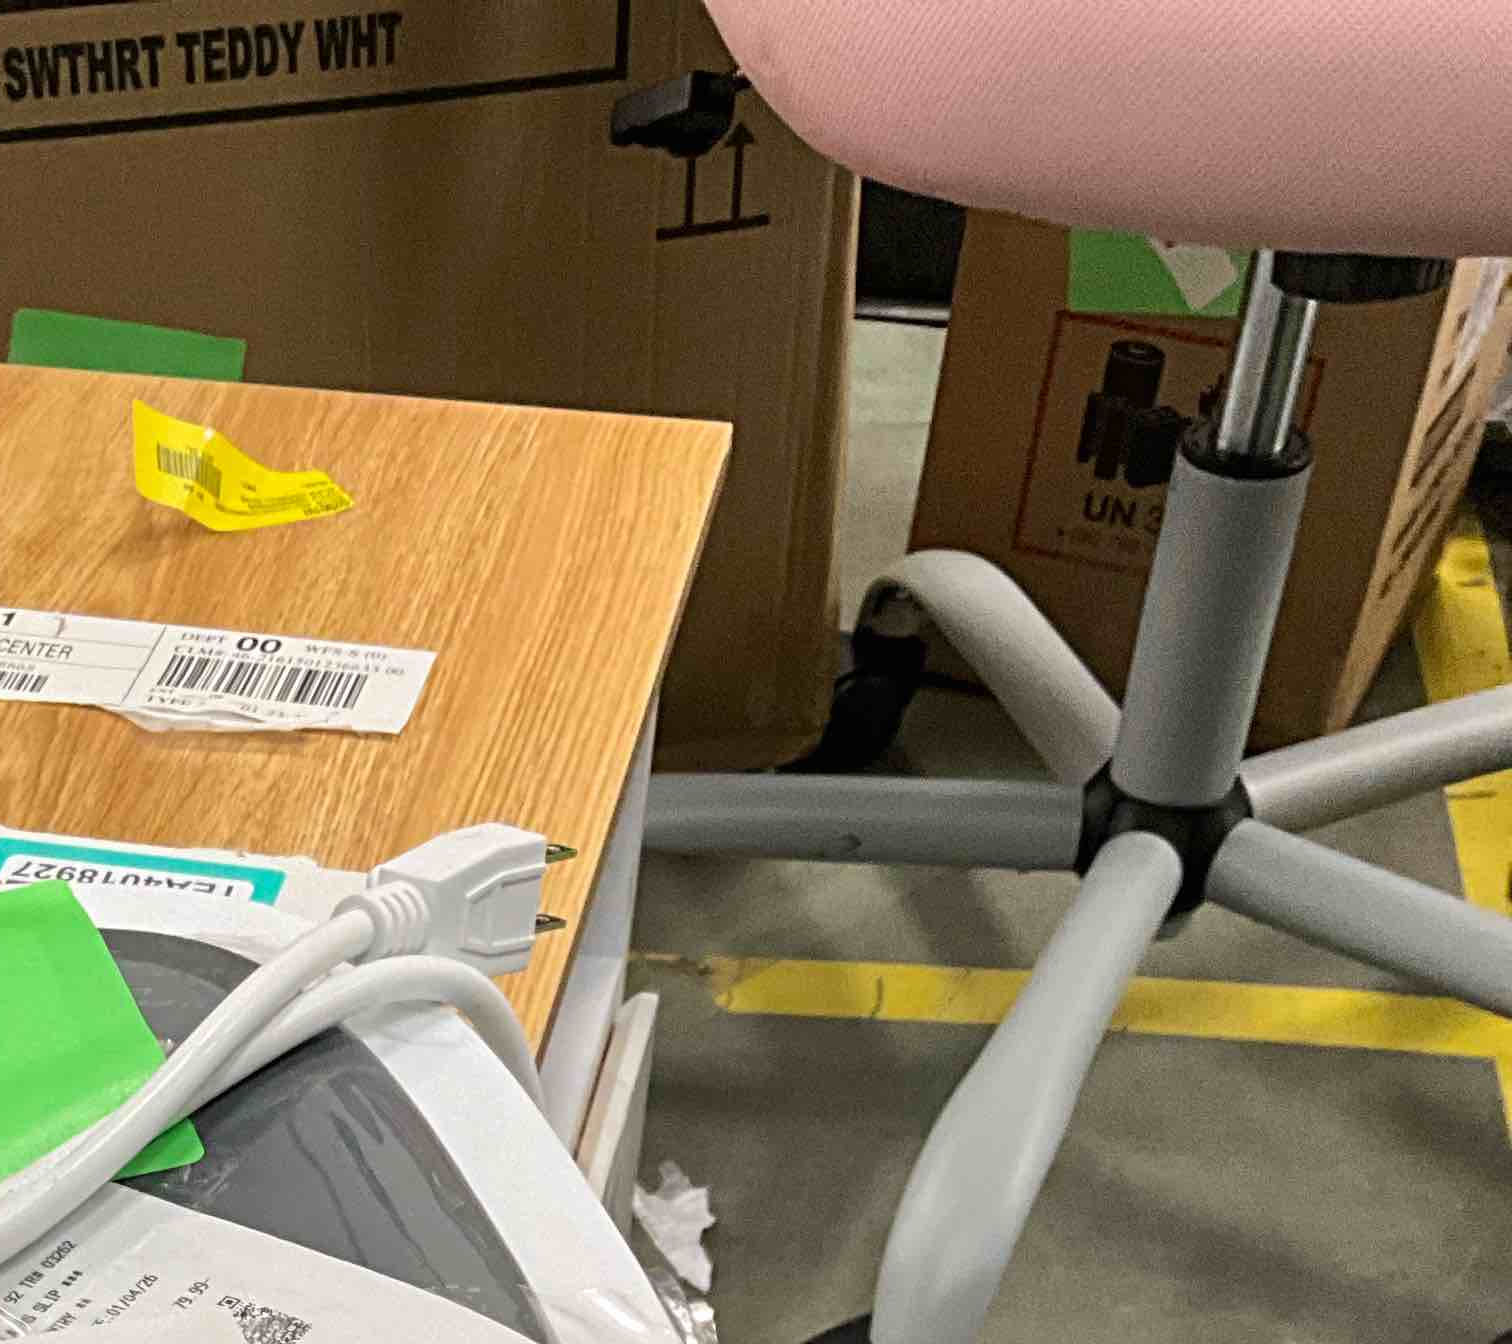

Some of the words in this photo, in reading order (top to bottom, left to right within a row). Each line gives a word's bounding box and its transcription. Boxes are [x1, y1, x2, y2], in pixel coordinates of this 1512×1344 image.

[2, 35, 165, 100] SWTHRT
[176, 20, 304, 84] TEDDY
[313, 11, 402, 71] WHT
[1083, 491, 1137, 527] UN
[237, 636, 283, 654] 00
